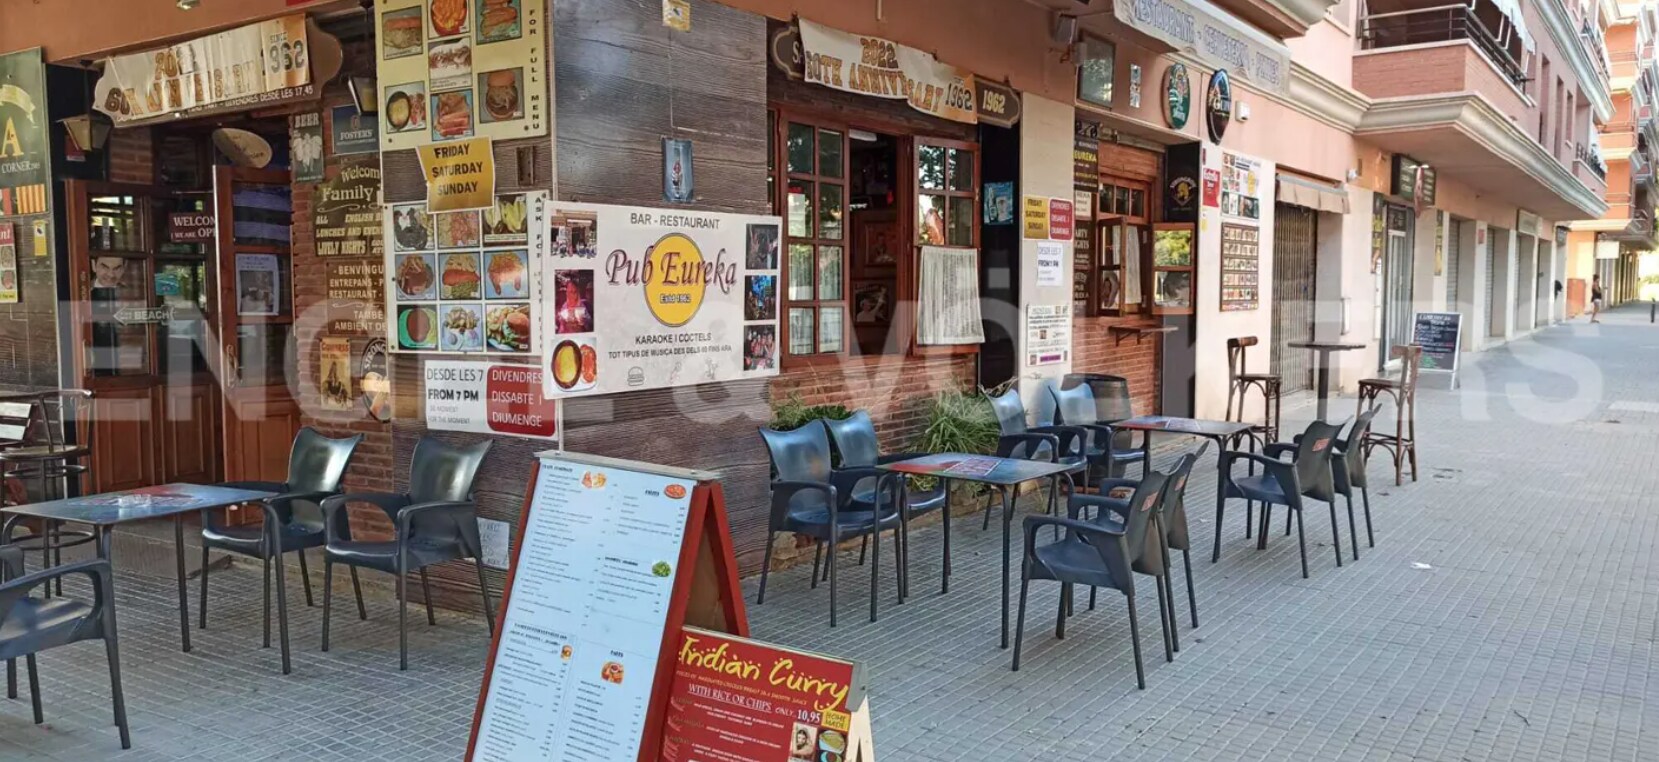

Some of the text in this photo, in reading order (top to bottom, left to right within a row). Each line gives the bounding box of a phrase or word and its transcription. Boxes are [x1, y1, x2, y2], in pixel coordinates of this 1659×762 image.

[280, 88, 294, 99] LES
[983, 90, 1007, 115] 1962
[296, 111, 321, 128] BEER
[531, 95, 540, 131] MENU
[434, 144, 470, 159] FRIDAY
[431, 161, 483, 178] SATURDAY
[322, 185, 375, 203] Family
[437, 182, 478, 197] SUNDAY
[344, 212, 374, 223] ENGLISH
[630, 212, 652, 226] BAR
[660, 213, 721, 231] RESTAURANT
[315, 228, 345, 238] LUNCHES
[347, 226, 363, 238] AND
[605, 245, 739, 295] Pub Eureka
[329, 278, 371, 289] ENTREPANS
[329, 290, 376, 301] RESTAURANT
[134, 310, 169, 321] BEACH
[334, 320, 370, 333] AMBIENT
[635, 334, 672, 345] KARAOKE
[679, 332, 712, 343] COCTELS
[608, 350, 621, 359] TOT
[623, 350, 640, 358] TIPUS
[641, 349, 649, 357] DE
[427, 368, 484, 384] DESDE LES 7
[492, 369, 543, 384] DIVENDRES
[428, 388, 479, 402] FROM 7 PM
[492, 390, 534, 405] DISSABTE
[492, 412, 543, 428] DIUMENGE
[679, 636, 762, 681] Indian
[768, 656, 851, 714] Curry
[689, 682, 773, 713] WITH RICE OR CHIPS
